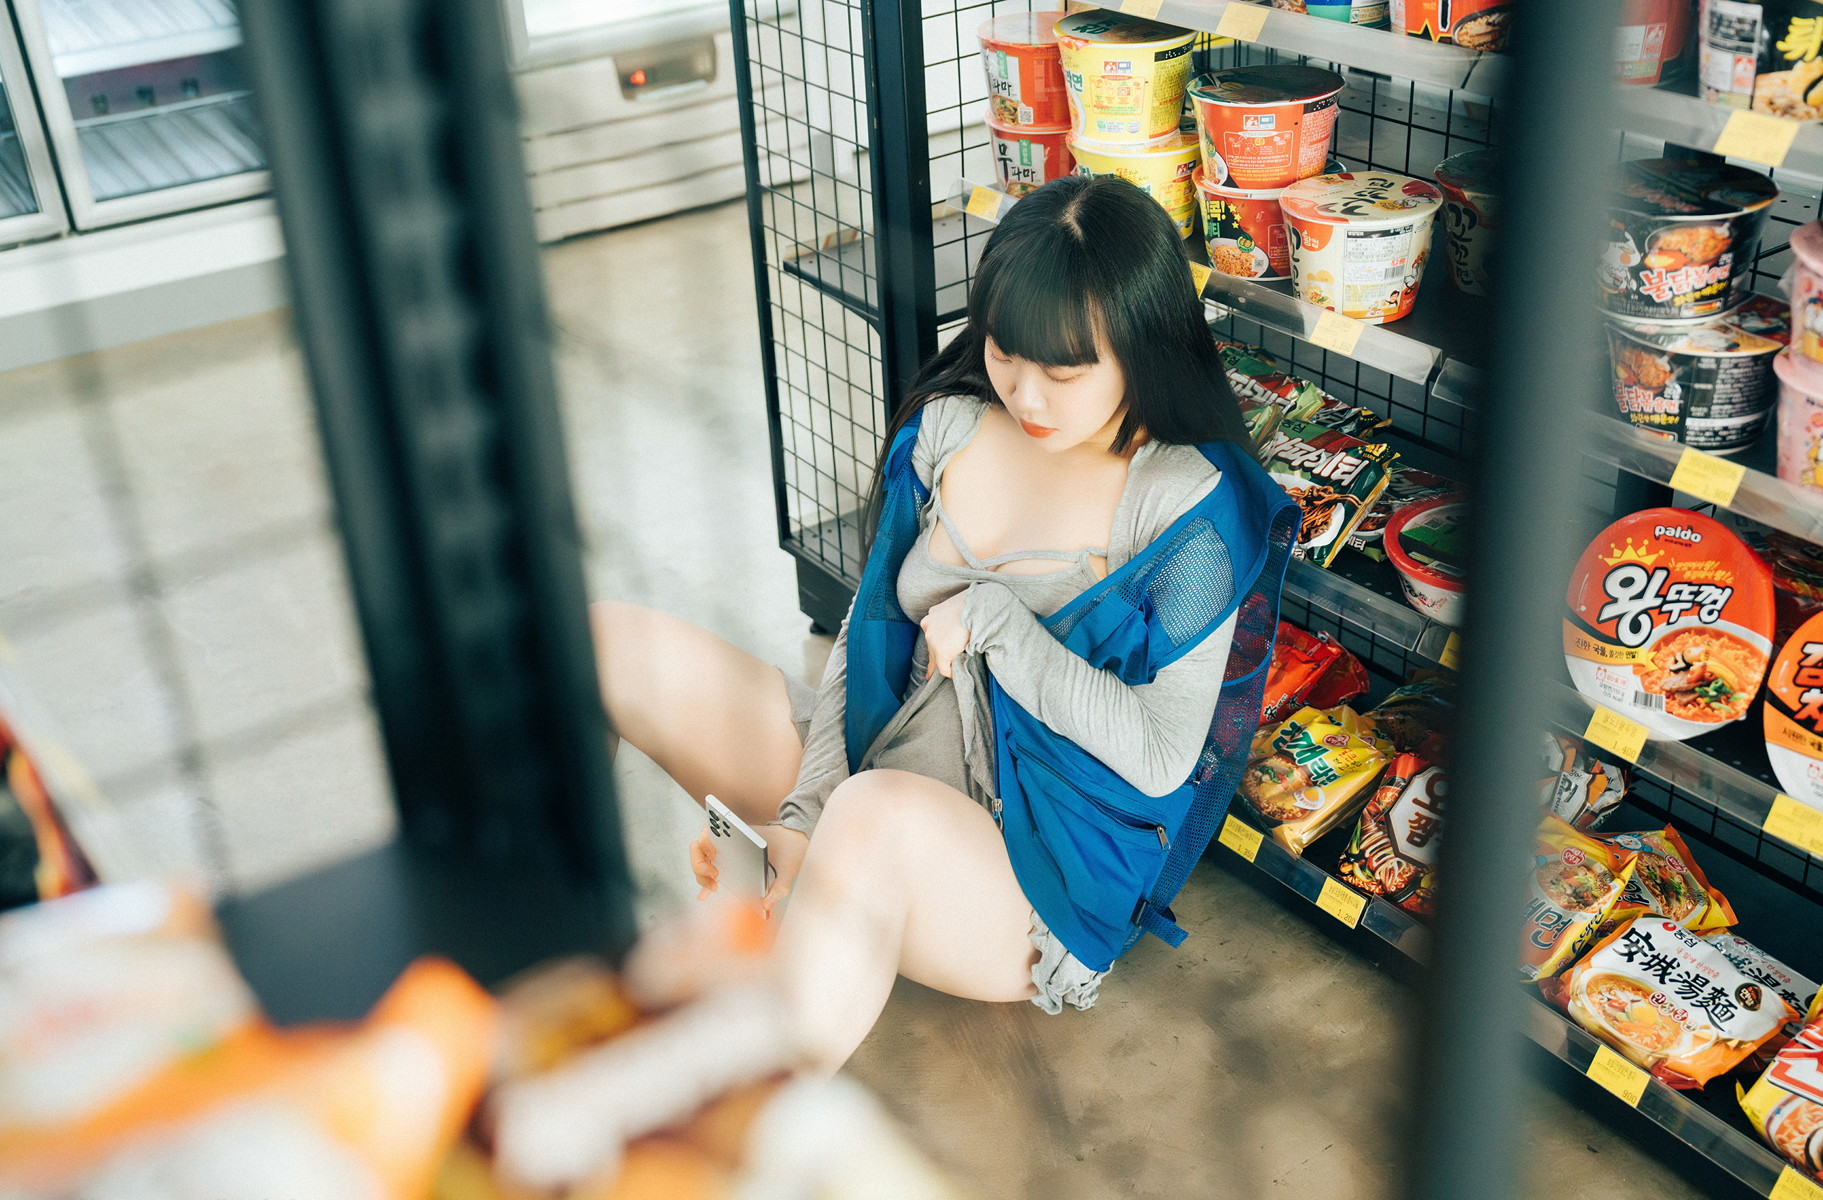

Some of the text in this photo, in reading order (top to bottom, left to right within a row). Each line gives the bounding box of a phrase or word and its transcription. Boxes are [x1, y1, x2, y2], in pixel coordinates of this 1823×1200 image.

[1654, 525, 1702, 543] paldo
[1596, 563, 1733, 648] 왕뚜껑
[1272, 721, 1343, 787] 참깨라면
[1674, 929, 1698, 948] 농심
[1622, 1088, 1638, 1105] 900
